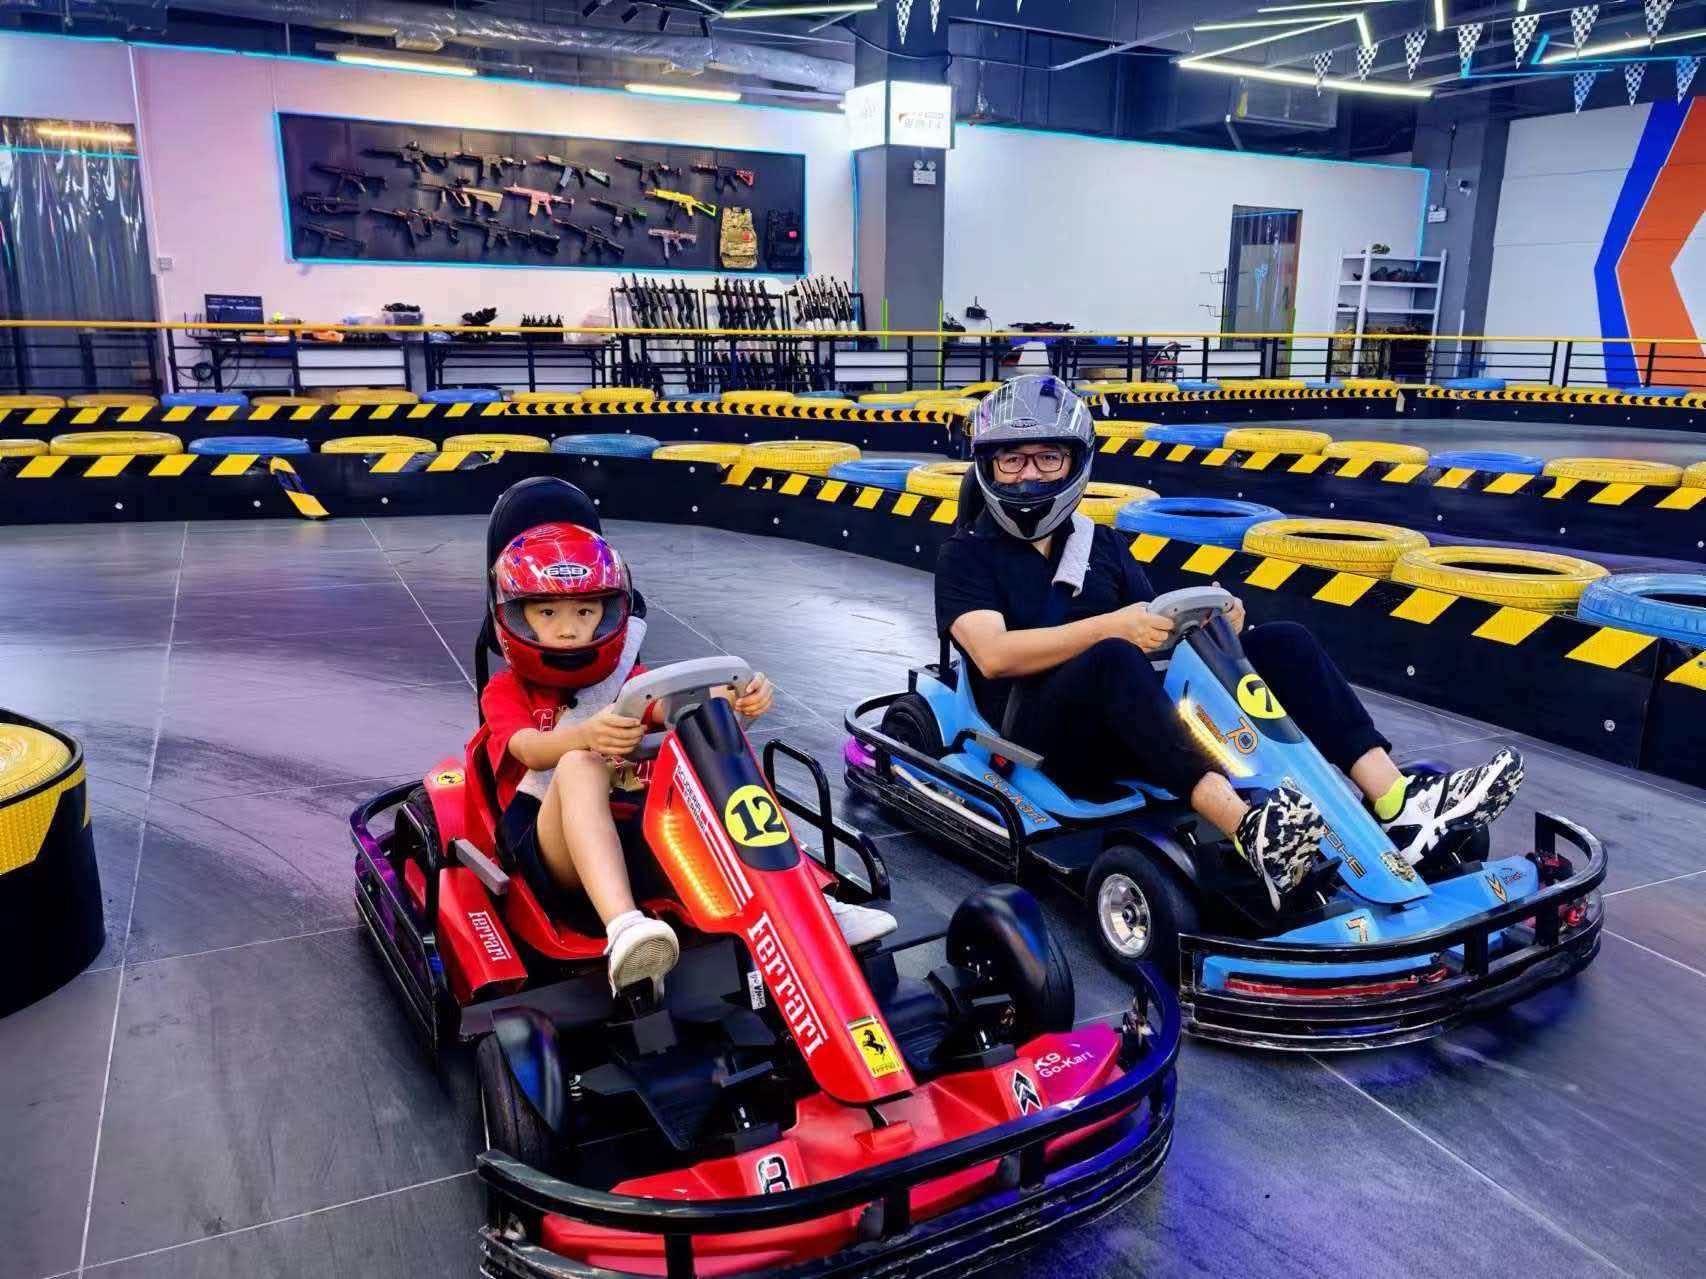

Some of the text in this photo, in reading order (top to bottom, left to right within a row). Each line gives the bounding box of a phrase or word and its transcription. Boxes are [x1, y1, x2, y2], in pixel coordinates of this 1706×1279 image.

[1246, 680, 1273, 712] 7
[731, 796, 787, 841] 12
[467, 911, 512, 960] Ferrari
[1345, 915, 1369, 944] 7
[747, 911, 829, 1057] Ferrari
[1040, 1051, 1095, 1078] Go-Kart
